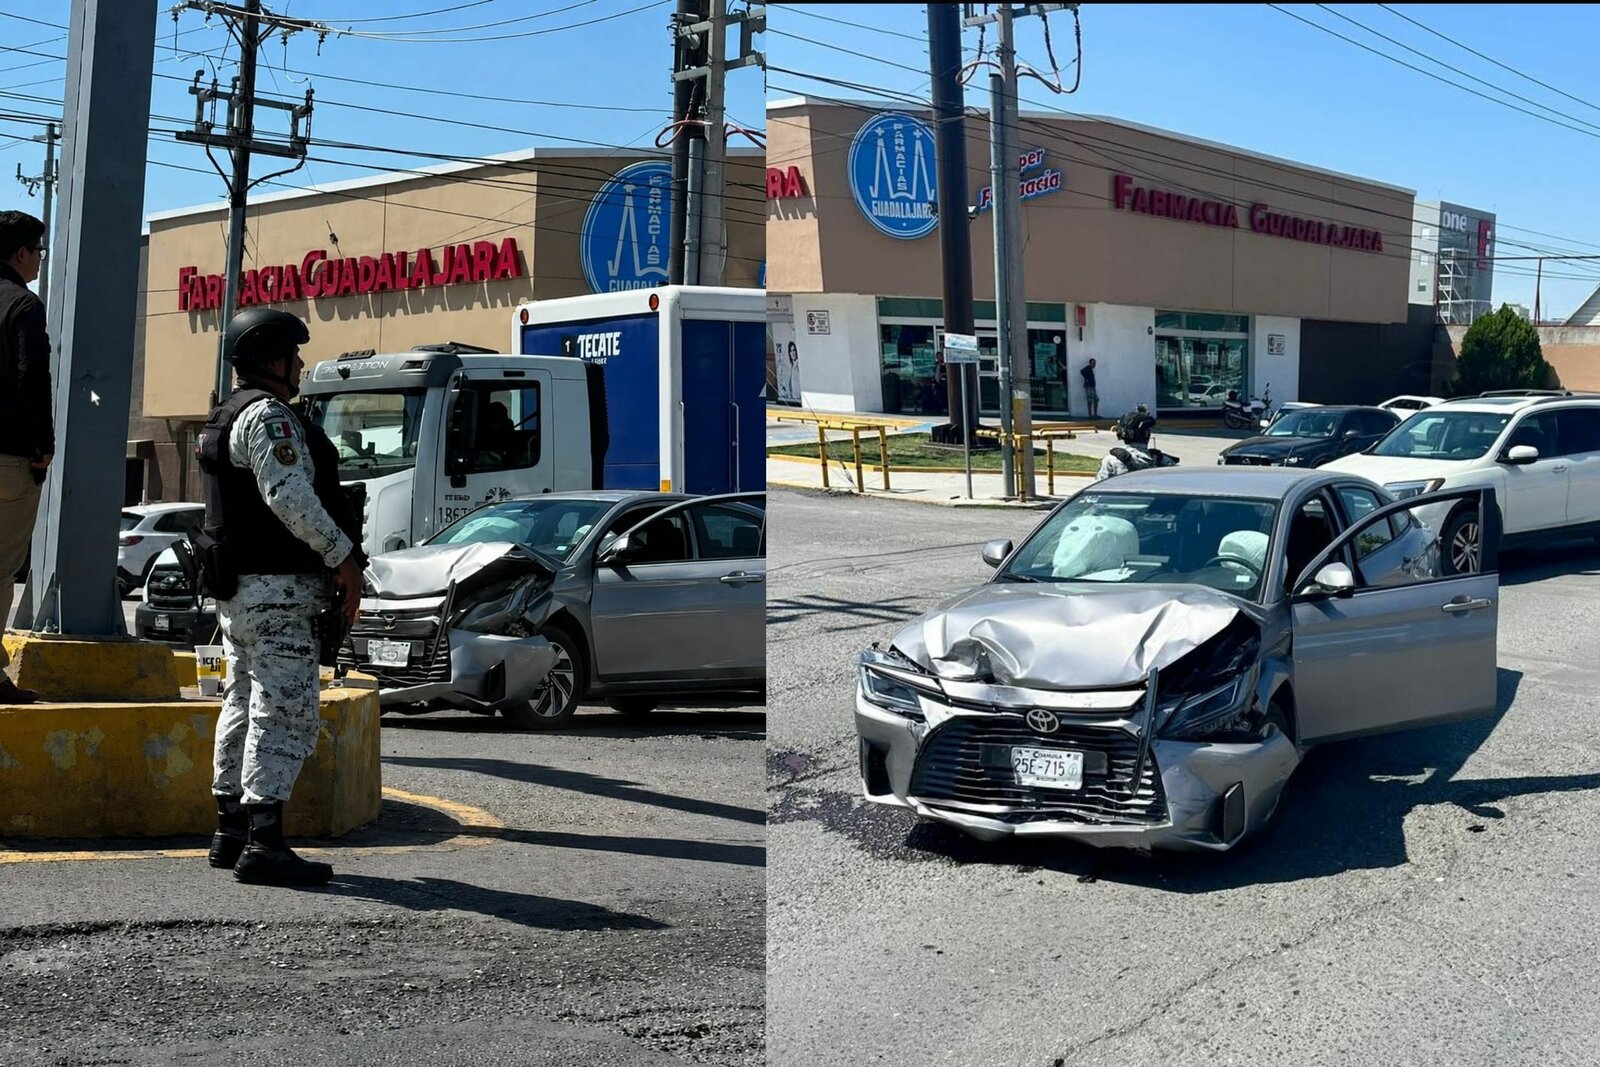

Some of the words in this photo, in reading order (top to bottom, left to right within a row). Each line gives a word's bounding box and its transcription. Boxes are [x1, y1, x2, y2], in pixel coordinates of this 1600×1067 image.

[1018, 149, 1045, 173] per
[980, 169, 1061, 210] Facia
[1113, 174, 1240, 229] FARMACIA
[1249, 202, 1384, 252] GUADALAJARA
[1442, 211, 1468, 231] one
[178, 264, 302, 312] FARACIA
[300, 237, 523, 298] GUADALAJARA
[577, 331, 622, 359] TECATE
